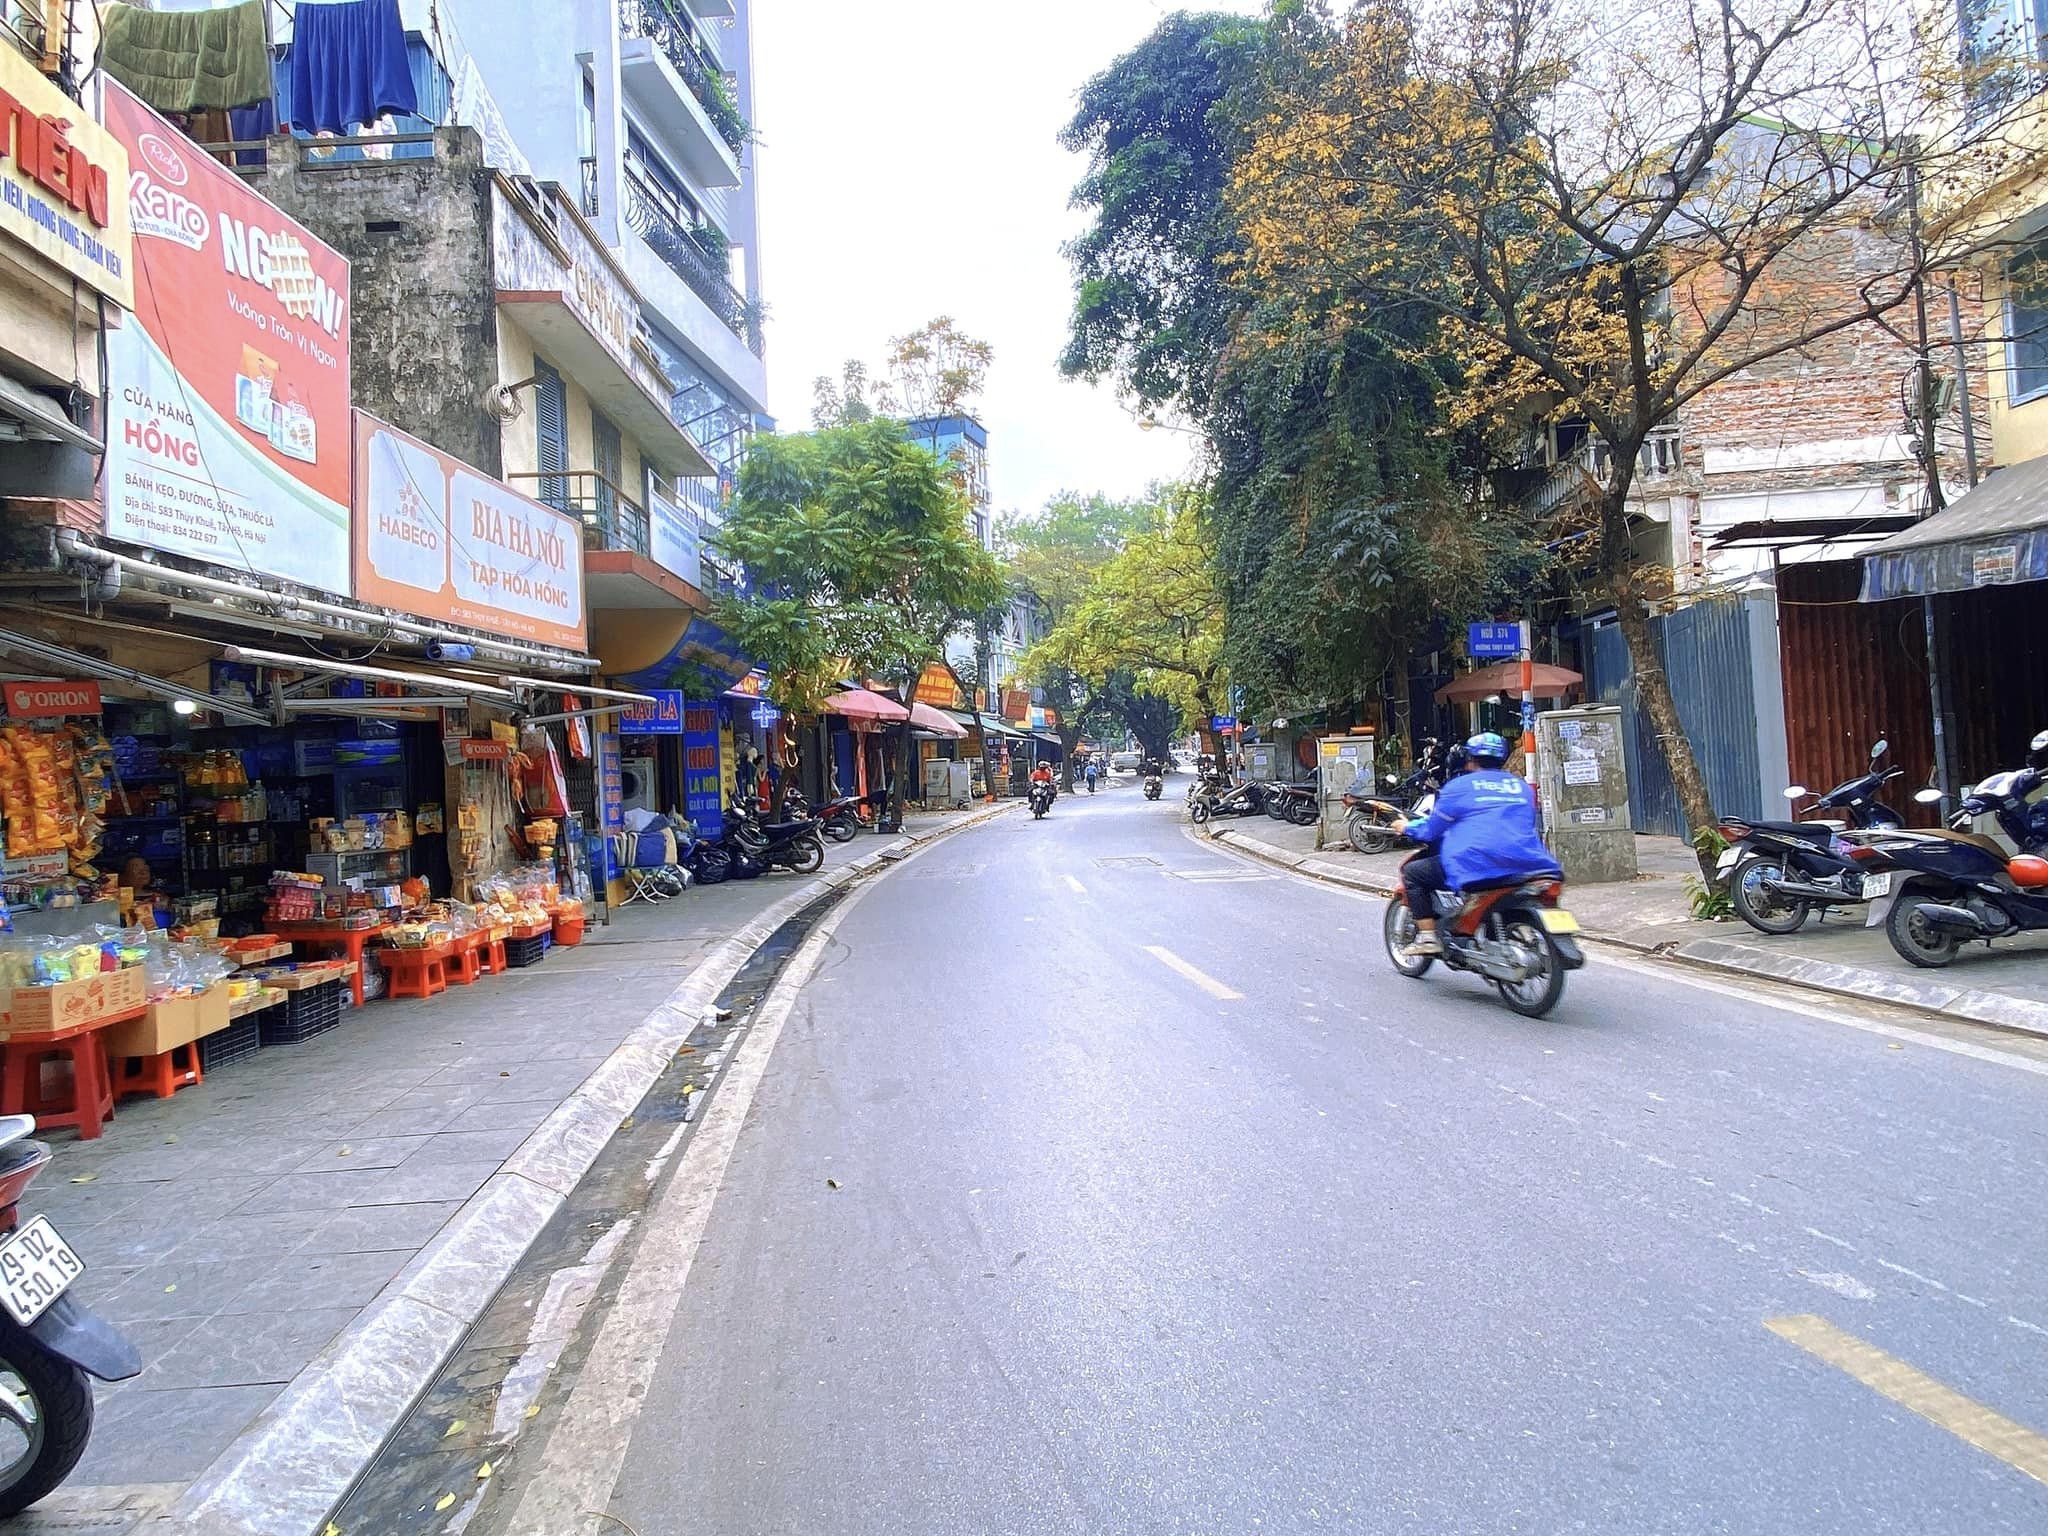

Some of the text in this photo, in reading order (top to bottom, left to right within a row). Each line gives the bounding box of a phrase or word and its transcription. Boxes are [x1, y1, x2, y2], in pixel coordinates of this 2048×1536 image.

[227, 287, 267, 331] Vuông
[269, 314, 294, 345] Tròn
[309, 339, 337, 369] Ngon
[124, 387, 194, 426] CỬA HÀNG
[125, 418, 198, 467] HỒNG
[125, 473, 153, 491] BÁNH
[155, 482, 177, 500] KẸO,
[125, 512, 146, 528] Điện
[379, 512, 437, 551] HABECO
[472, 498, 567, 576] BIA HÀ NỘI
[470, 560, 498, 592] TẠP
[35, 691, 90, 707] ORION
[659, 694, 679, 720] LÀ
[475, 744, 502, 754] ORION
[0, 1229, 54, 1286] 29-D2
[11, 1249, 78, 1314] 450.19
